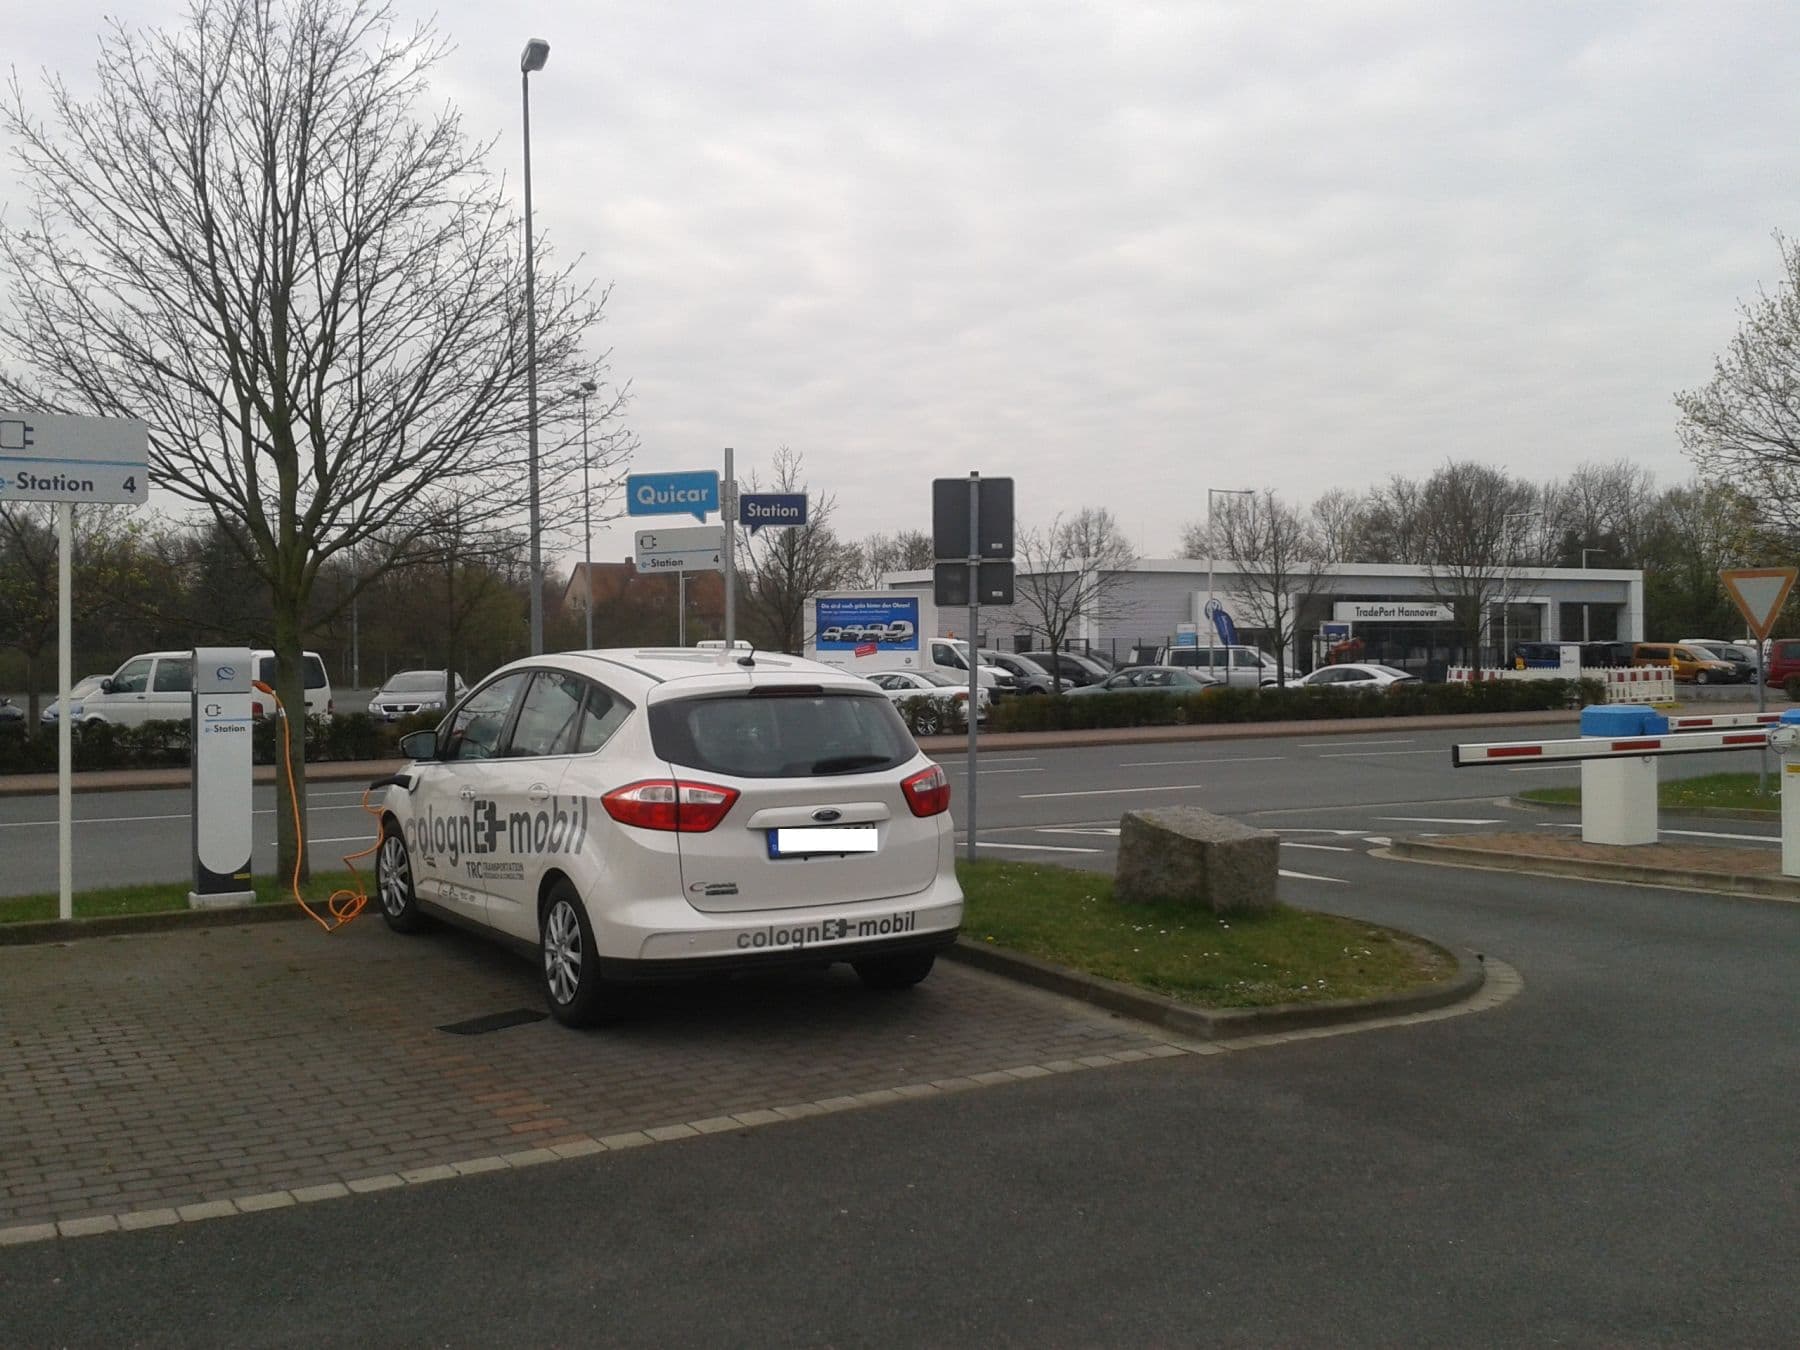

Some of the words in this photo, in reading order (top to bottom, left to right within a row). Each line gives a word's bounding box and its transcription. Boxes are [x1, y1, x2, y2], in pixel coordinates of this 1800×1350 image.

[122, 476, 137, 493] 4
[637, 485, 709, 505] Quicar
[747, 502, 799, 517] Station
[712, 554, 720, 564] 4
[1355, 606, 1396, 617] TradePort
[1398, 606, 1438, 617] Hannover
[466, 861, 483, 879] TRC
